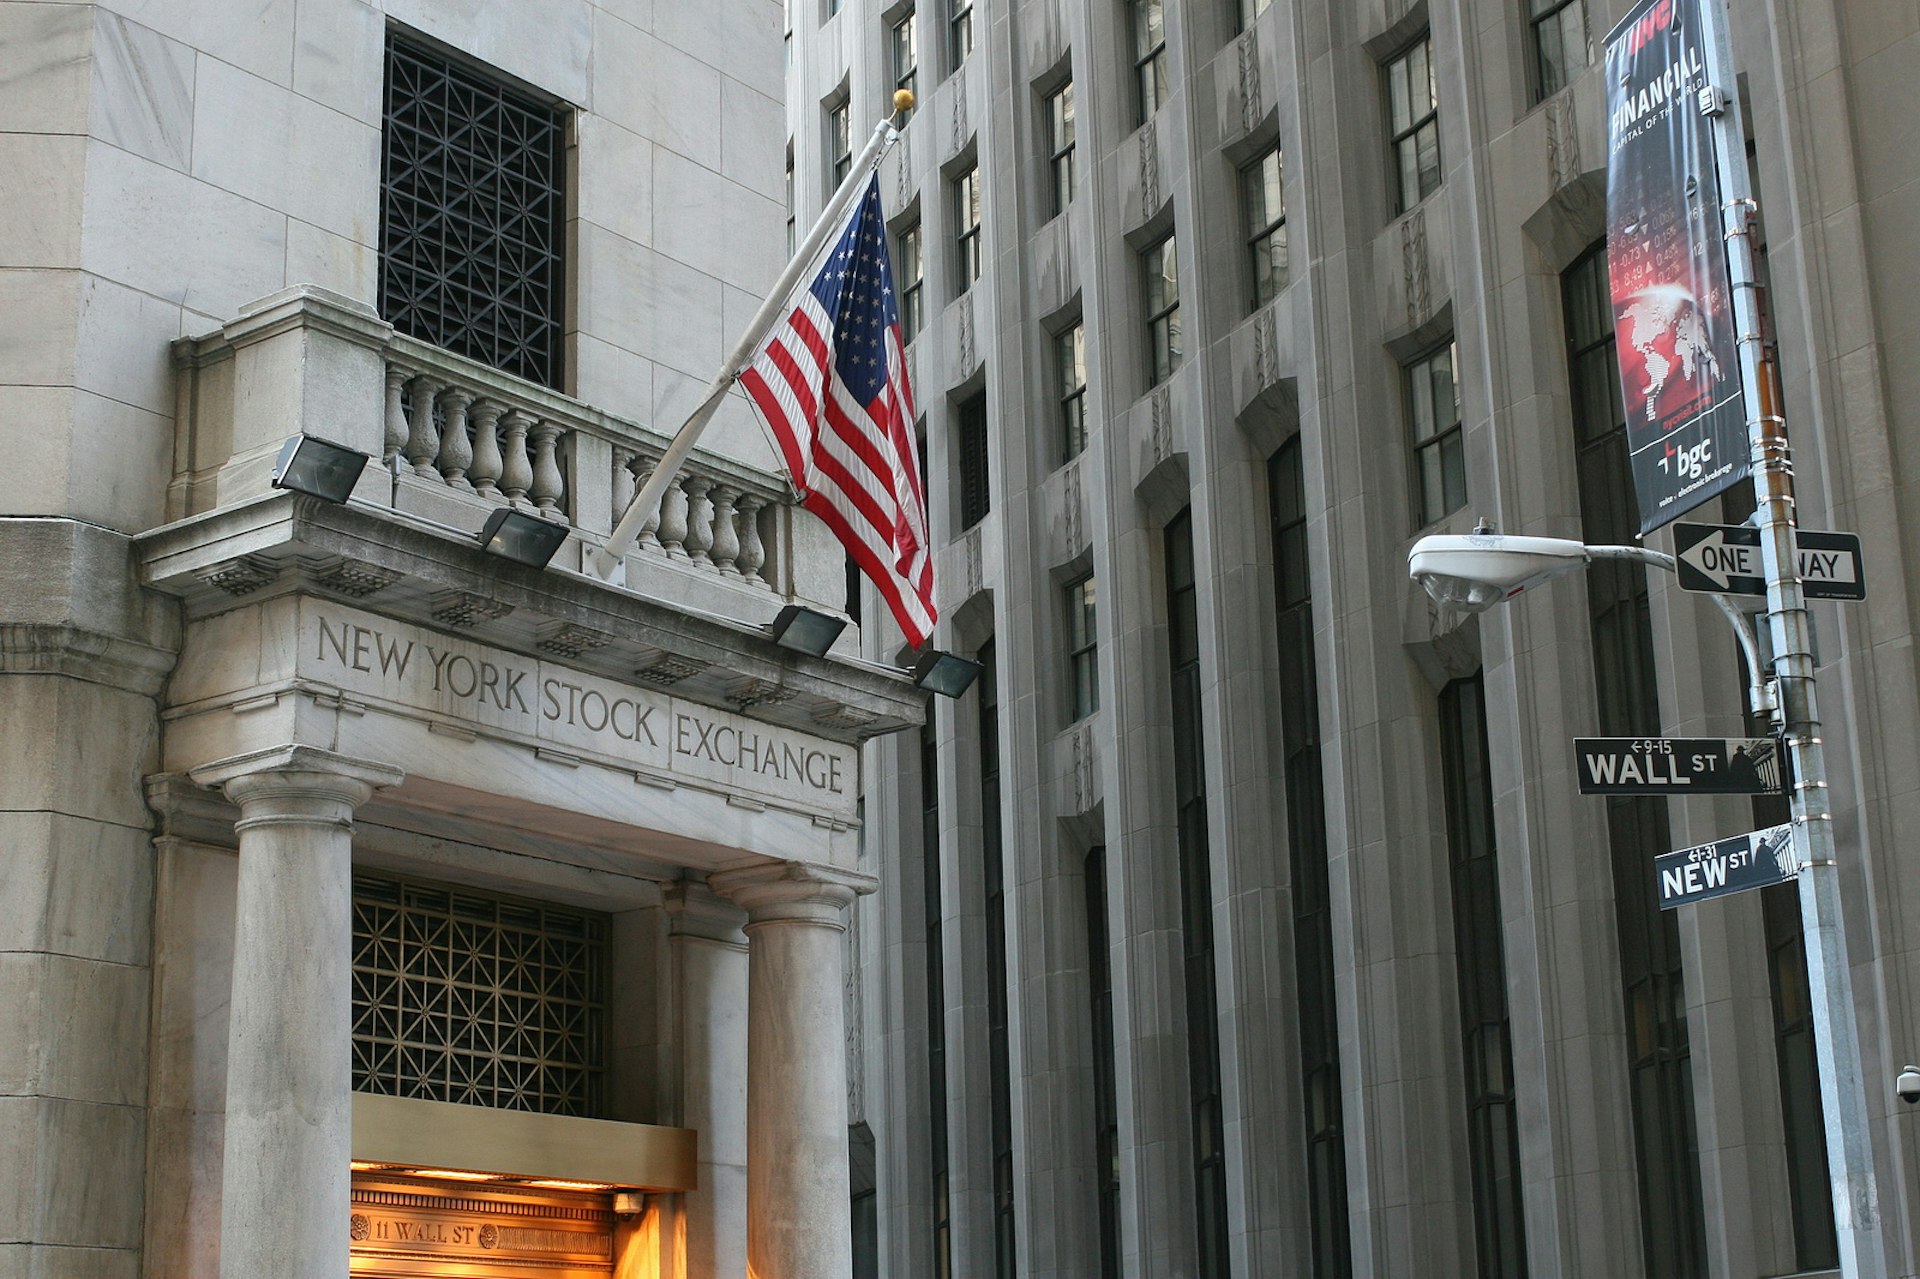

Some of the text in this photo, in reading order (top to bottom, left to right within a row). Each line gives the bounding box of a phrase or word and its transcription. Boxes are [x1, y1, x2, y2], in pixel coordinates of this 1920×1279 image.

[1612, 46, 1701, 140] FINANCIAL
[1613, 78, 1703, 155] CAPITAL OF THE WRLD
[1677, 438, 1712, 479] bgc
[1701, 545, 1752, 573] ONE
[317, 616, 843, 795] NEW YORK STOCK EXCHANGE
[1644, 740, 1672, 754] 9-15
[1586, 754, 1717, 784] WALL ST
[1696, 845, 1717, 862] 1-31
[1662, 851, 1748, 899] NEW ST
[376, 1220, 474, 1245] 11 WALL ST
